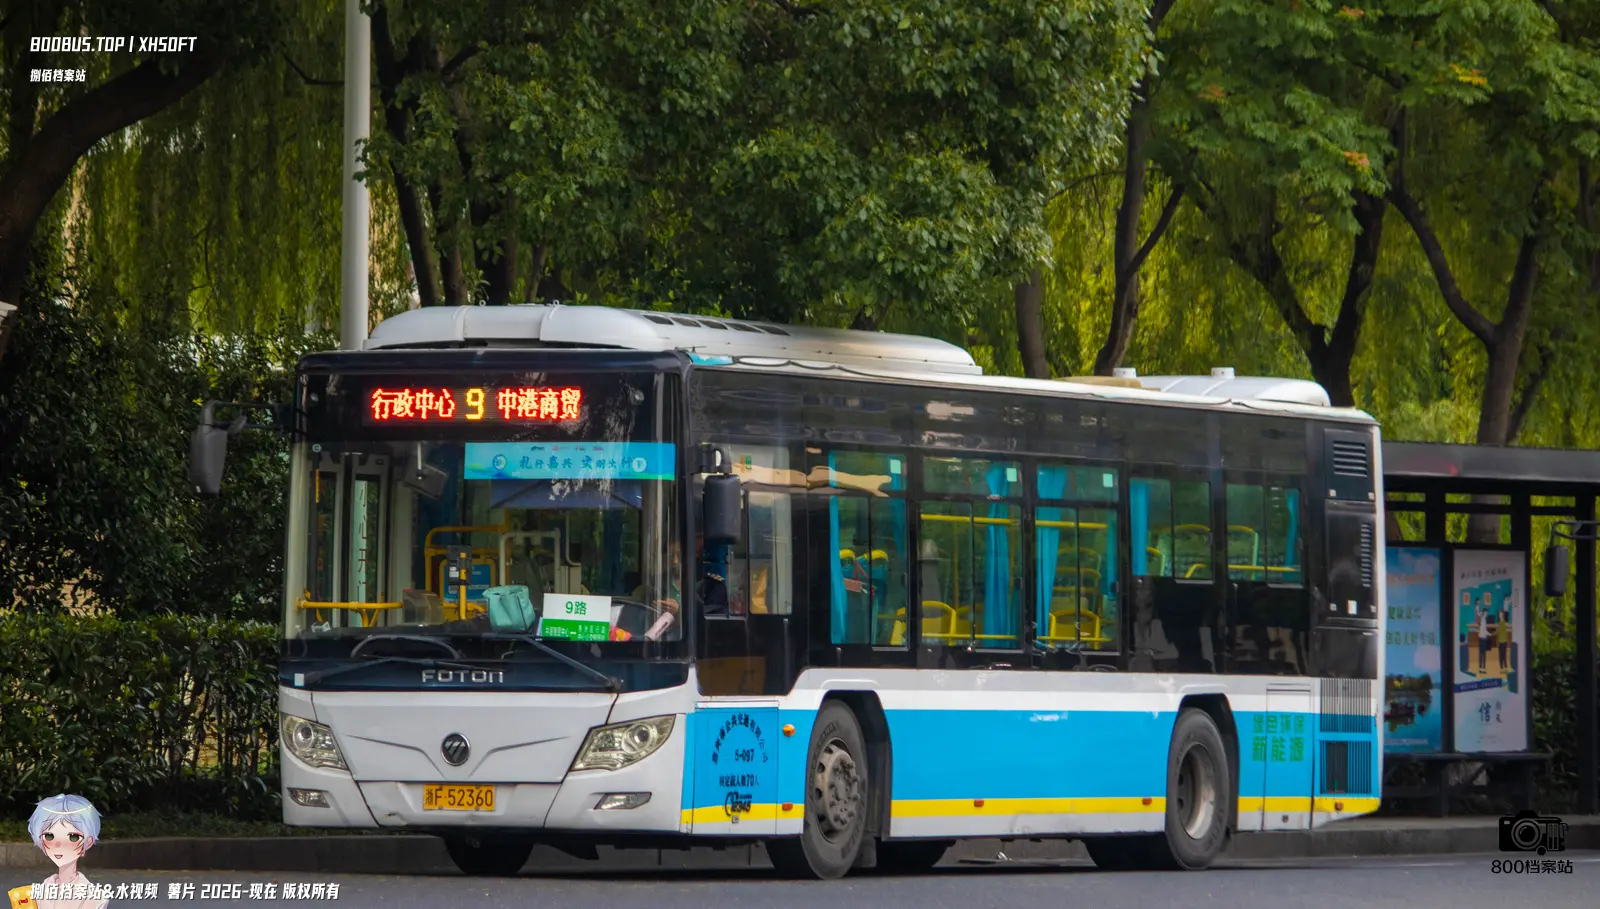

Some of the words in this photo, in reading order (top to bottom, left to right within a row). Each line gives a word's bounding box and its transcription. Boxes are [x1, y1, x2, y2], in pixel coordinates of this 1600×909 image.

[371, 388, 456, 420] 行政中心
[465, 388, 486, 420] 9
[497, 388, 582, 420] 中港商贸
[565, 600, 588, 616] 9路
[421, 669, 504, 683] FOTON
[1252, 736, 1305, 762] 新能源
